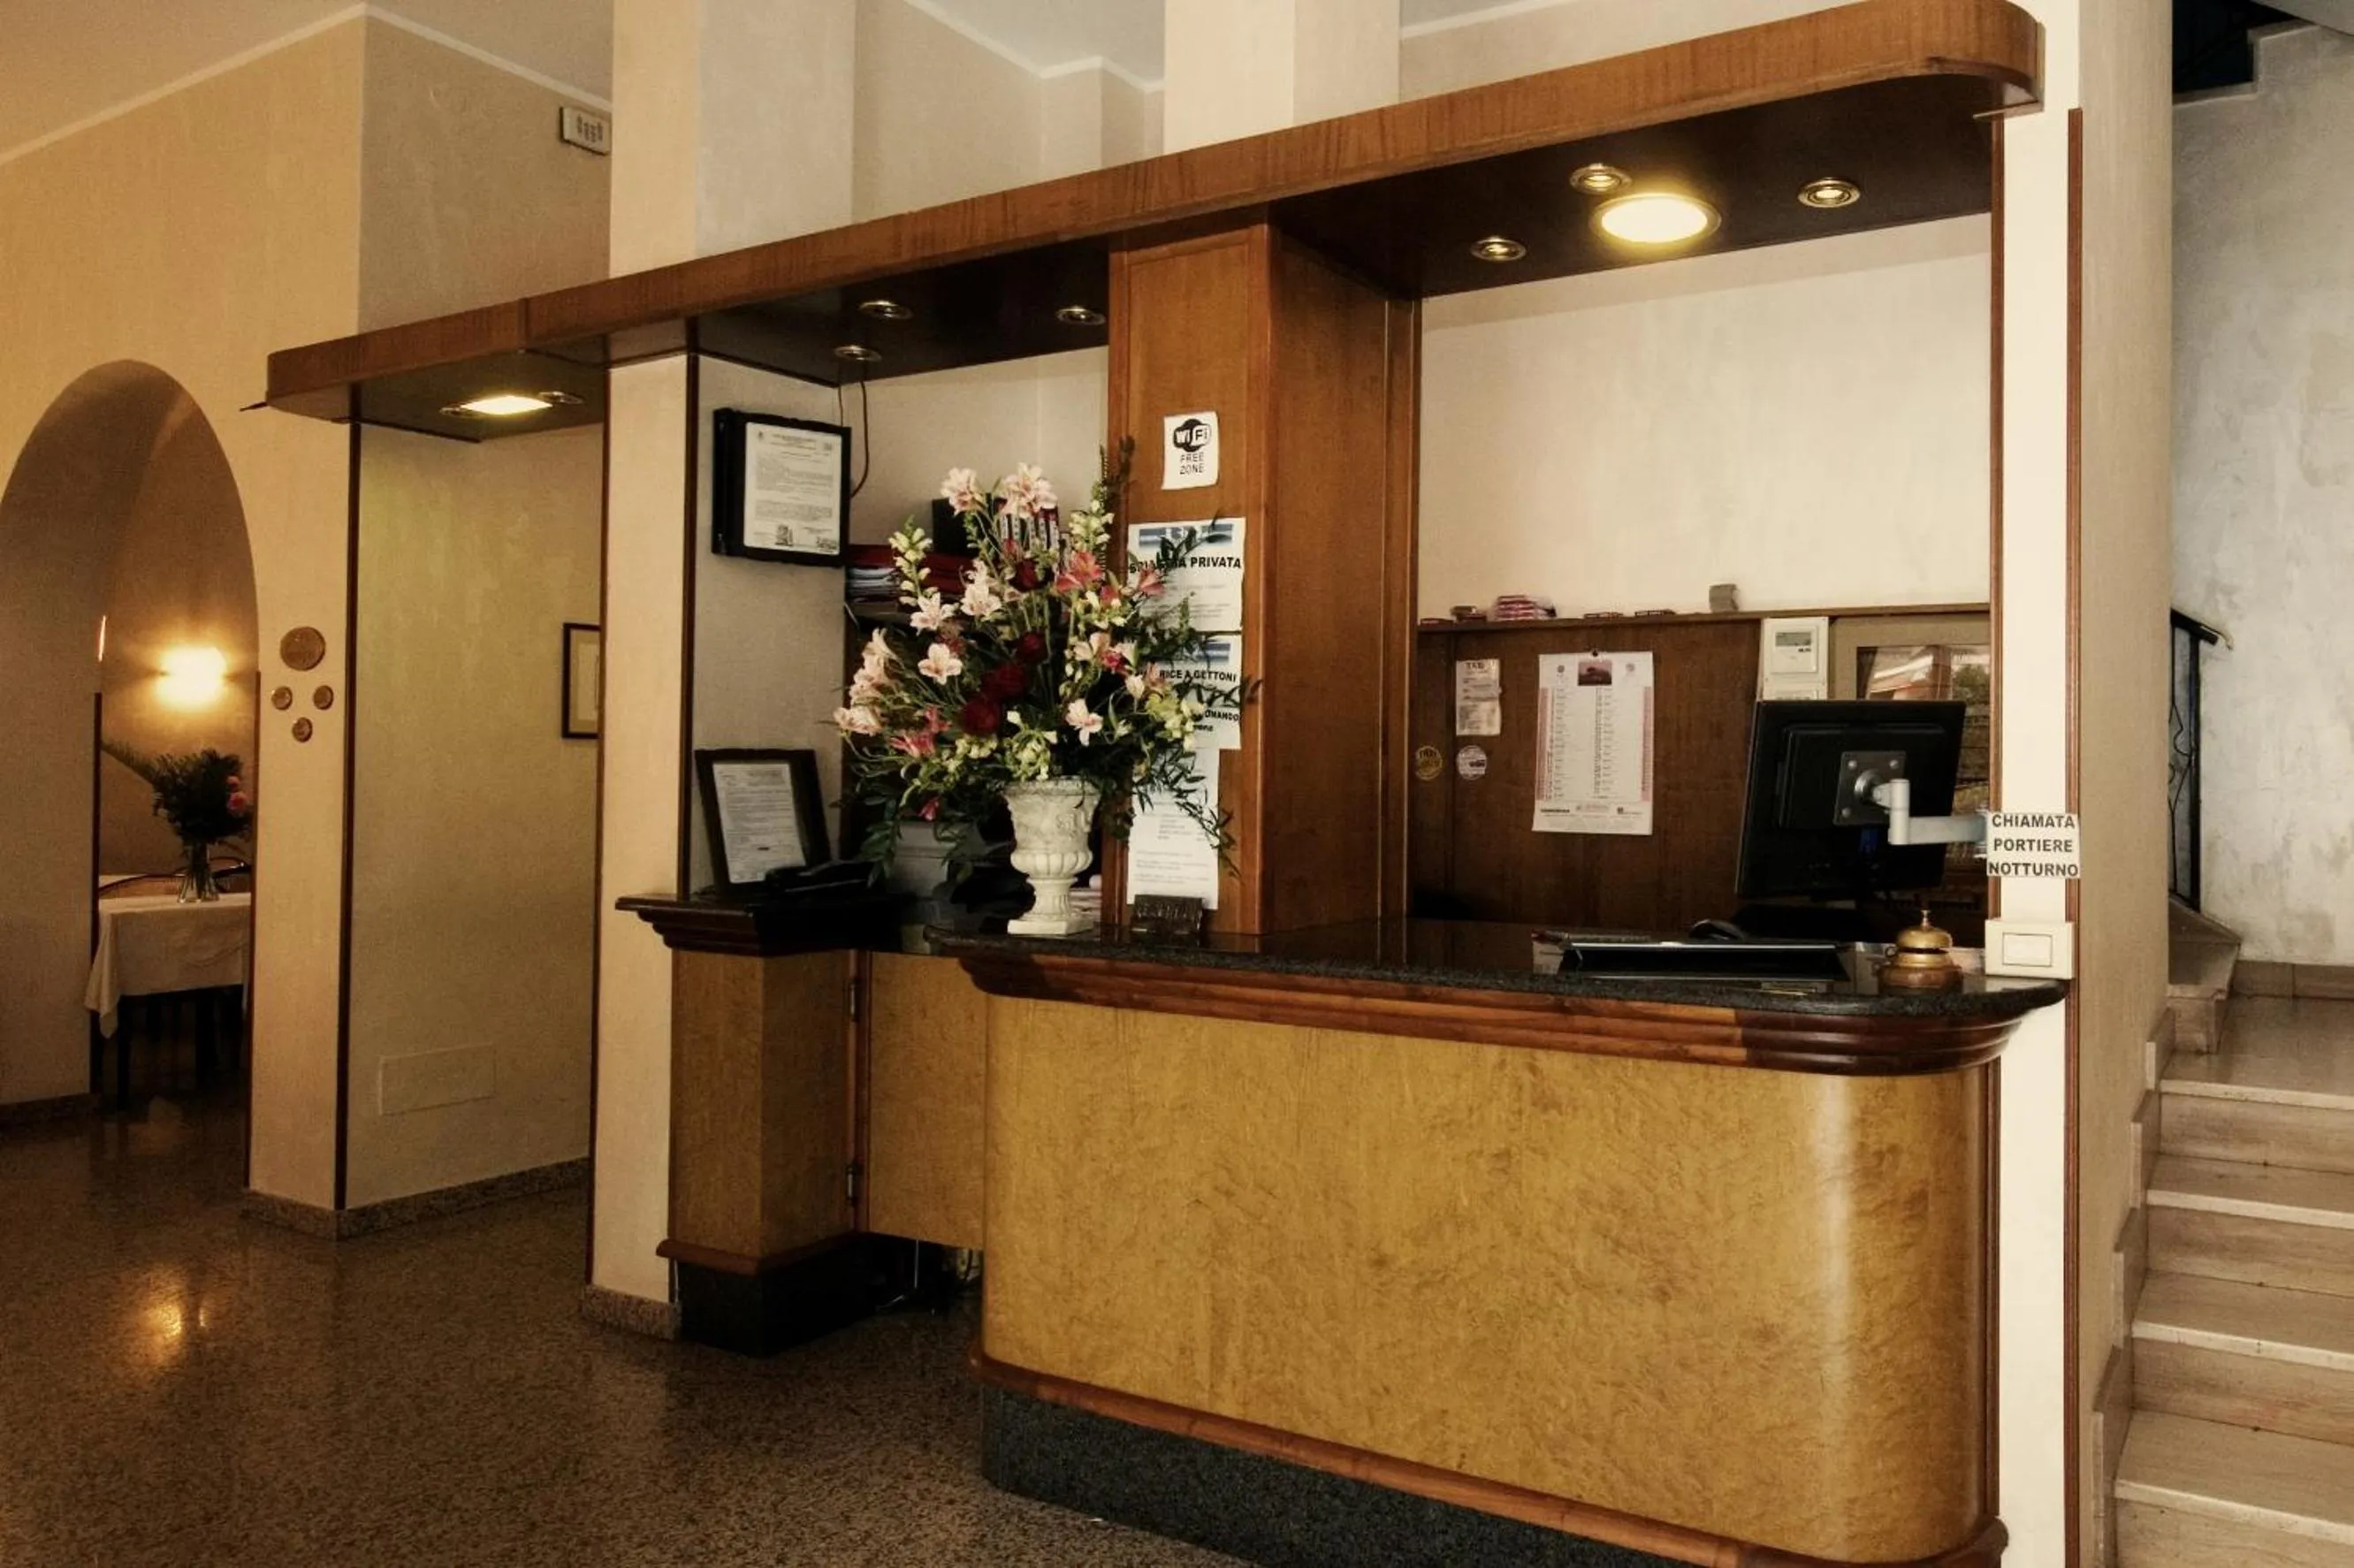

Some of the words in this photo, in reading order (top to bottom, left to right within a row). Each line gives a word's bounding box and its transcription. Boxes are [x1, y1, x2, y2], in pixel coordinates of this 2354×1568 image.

[1180, 452, 1204, 463] FREE
[1180, 463, 1204, 475] ZONE
[1191, 556, 1241, 568] PRIVATA
[1193, 670, 1236, 682] GETTONI
[1205, 709, 1239, 721] OMANDO
[1992, 814, 2075, 828] CHIAMATA
[1994, 838, 2072, 852] PORTIERE
[1988, 862, 2078, 876] NOTTURNO
